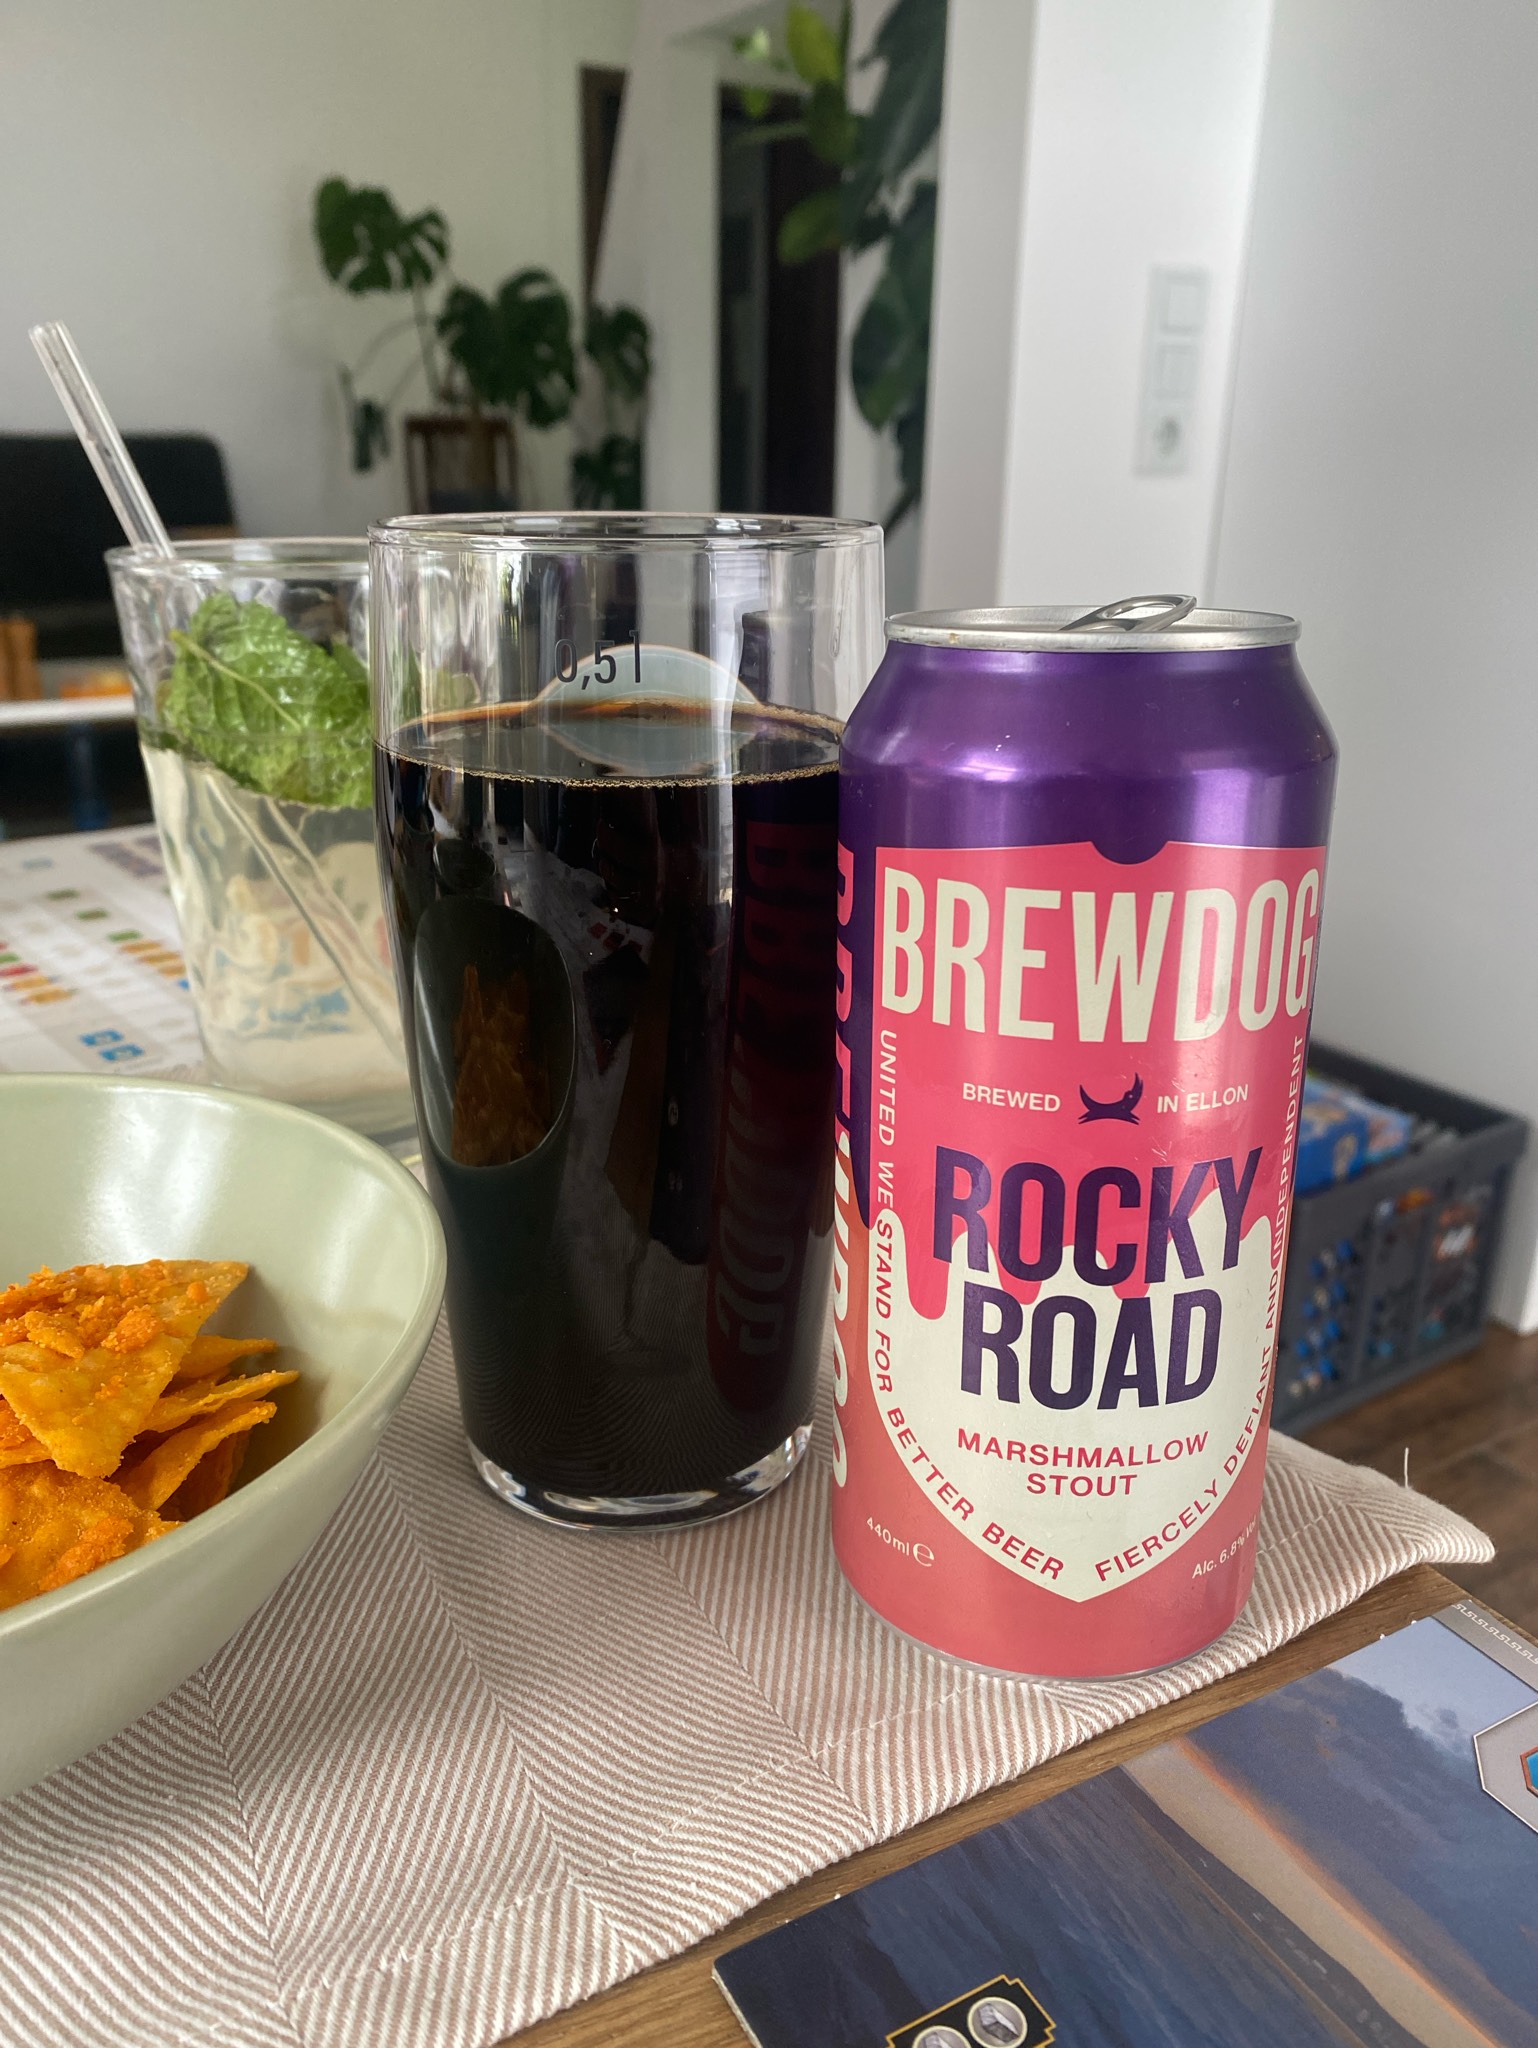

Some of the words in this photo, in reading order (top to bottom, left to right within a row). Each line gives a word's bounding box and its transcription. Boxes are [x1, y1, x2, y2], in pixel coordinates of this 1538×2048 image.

[555, 639, 617, 690] 0,5
[881, 867, 1320, 1043] BREWDOG
[877, 1029, 897, 1147] UNITED
[962, 1082, 1061, 1112] BREWED
[1156, 1095, 1179, 1114] IN
[1185, 1083, 1249, 1113] ELLON
[1272, 1035, 1303, 1260] INDEPENDENT
[876, 1161, 895, 1208] WE
[932, 1145, 1264, 1287] ROCKY
[875, 1217, 893, 1319] STAND
[1265, 1269, 1280, 1330] AND
[875, 1328, 893, 1393] FOR
[960, 1280, 1223, 1411] ROAD
[1223, 1345, 1271, 1477] DEFIANT
[887, 1407, 975, 1521] BETTER
[957, 1428, 1210, 1468] MARSHMALLOW
[1026, 1473, 1138, 1498] STOUT
[866, 1515, 910, 1557] 440ml
[981, 1521, 1065, 1581] BEER
[1094, 1479, 1220, 1582] FIERCELY
[1191, 1560, 1218, 1579] Alc.
[1219, 1534, 1246, 1564] 6.8%
